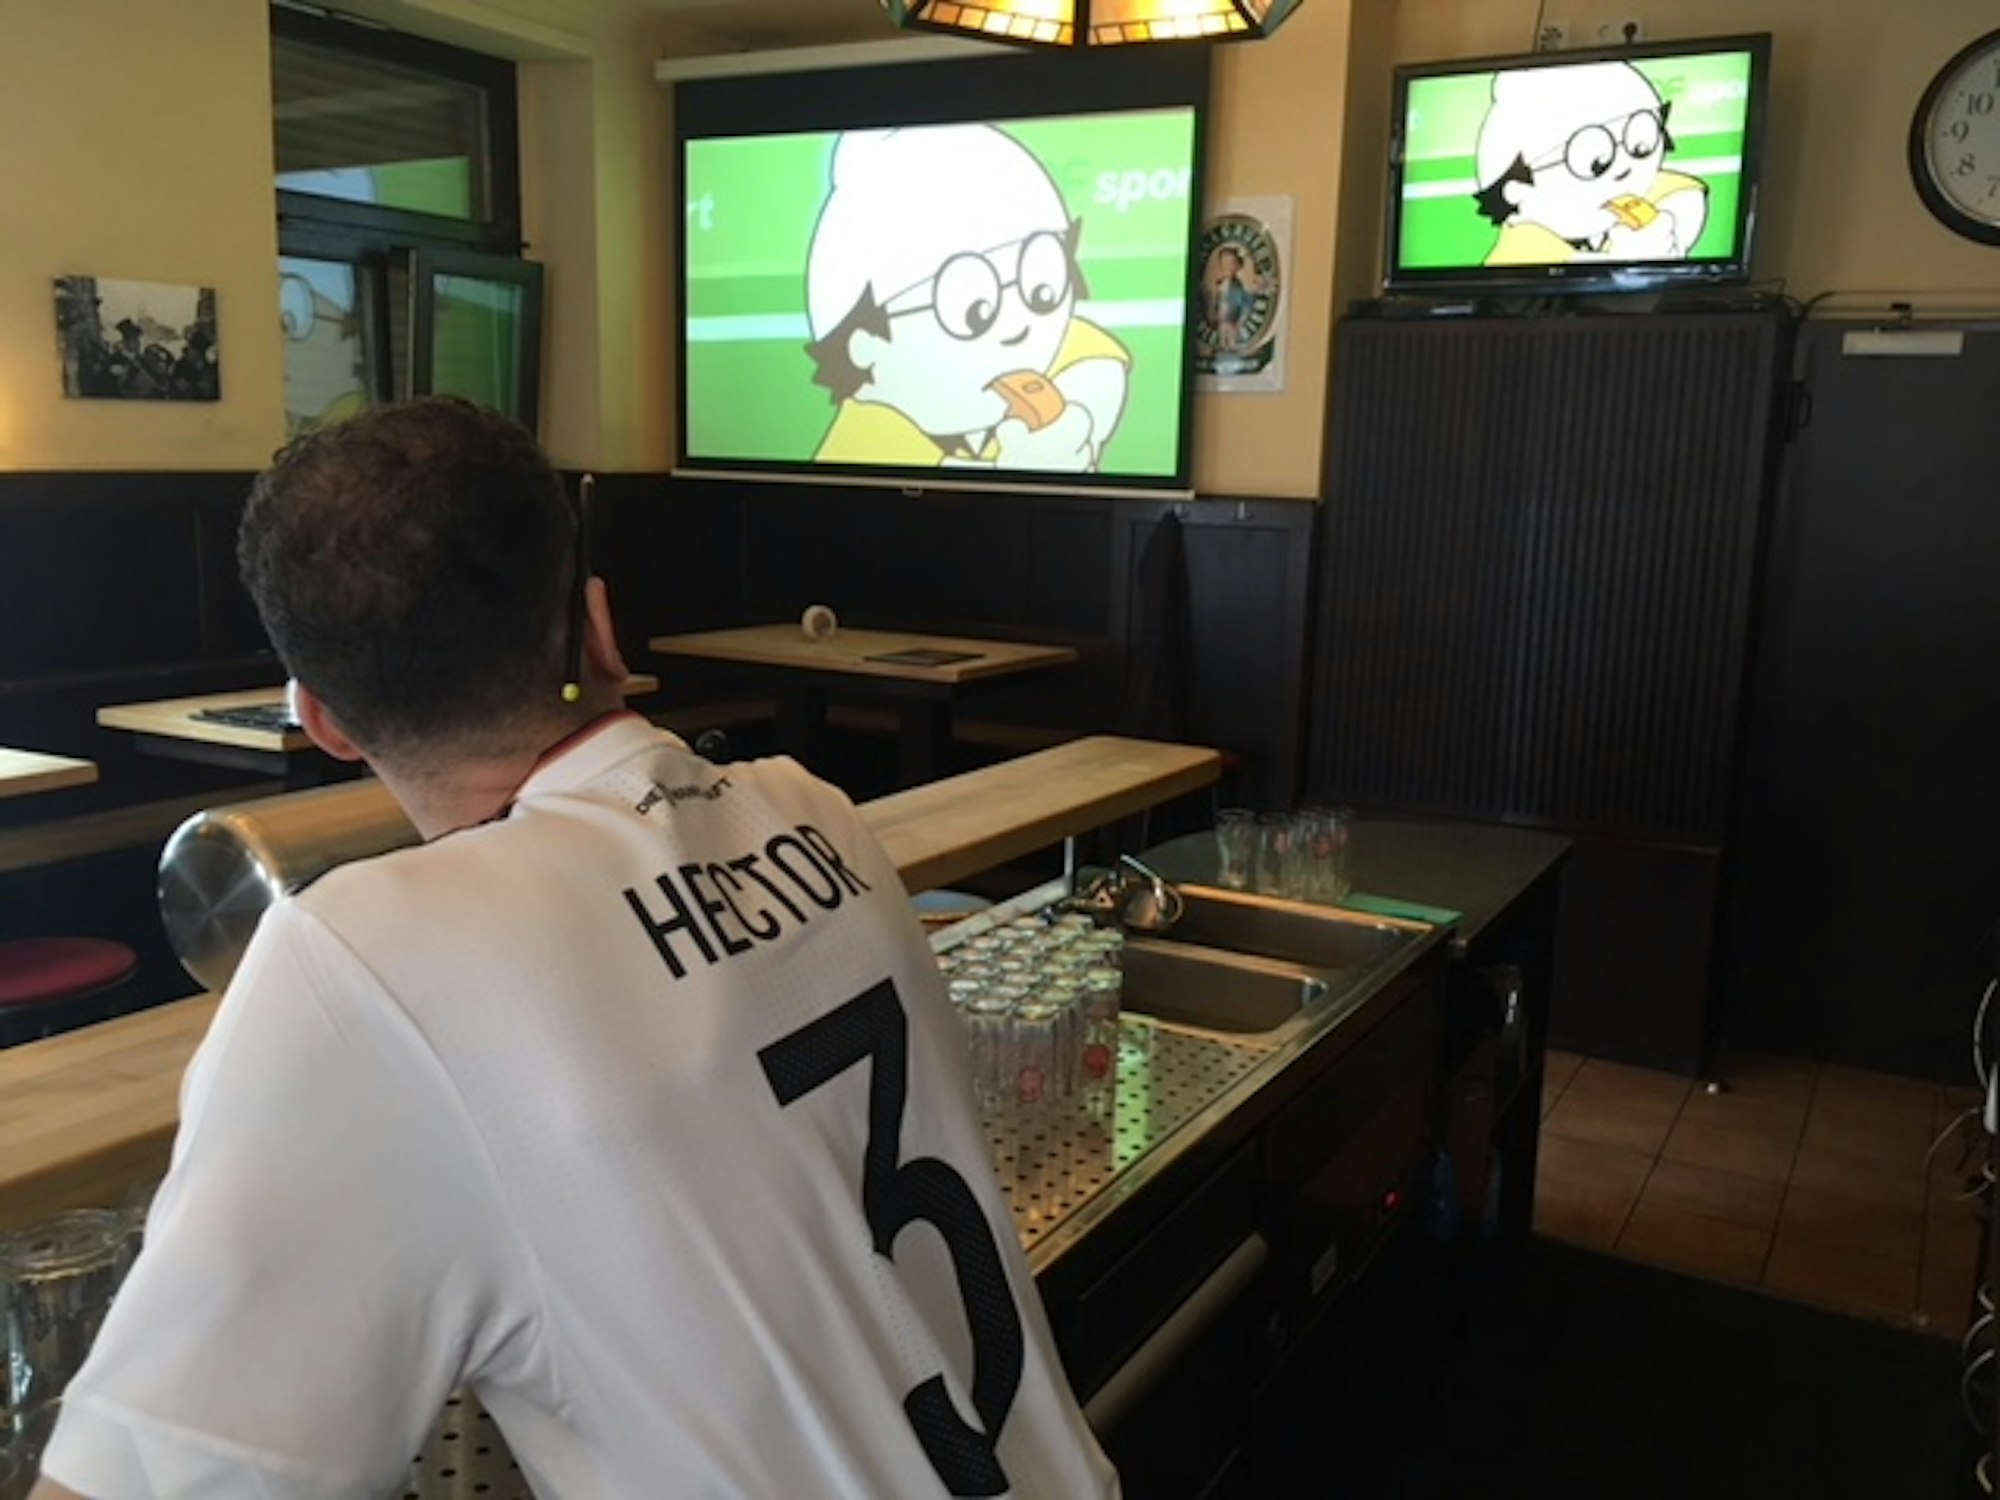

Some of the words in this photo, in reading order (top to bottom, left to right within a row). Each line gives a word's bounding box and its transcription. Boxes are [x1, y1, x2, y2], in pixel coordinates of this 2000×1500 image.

[1967, 92, 1994, 116] 10
[1951, 121, 1970, 143] 9
[1958, 153, 1975, 176] 8
[622, 823, 872, 981] HECTOR
[756, 976, 1025, 1497] 3
